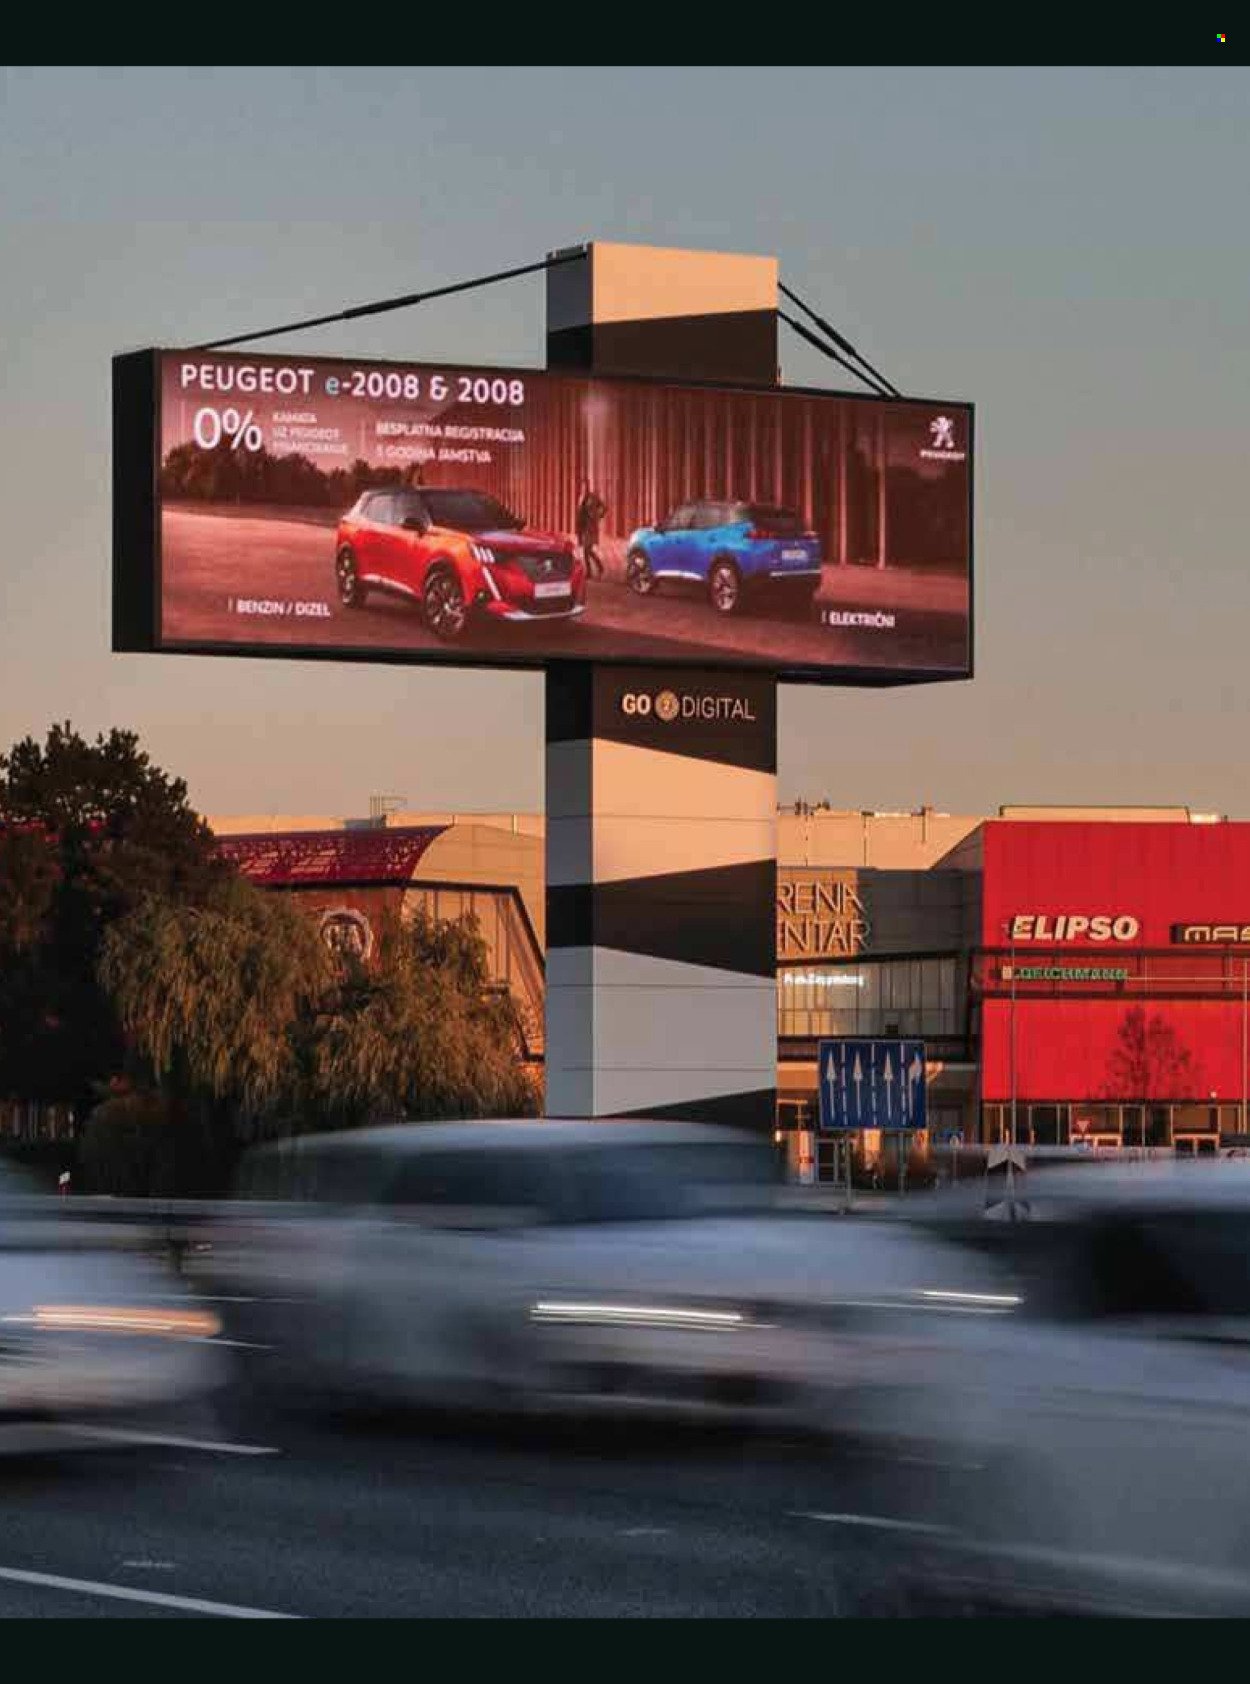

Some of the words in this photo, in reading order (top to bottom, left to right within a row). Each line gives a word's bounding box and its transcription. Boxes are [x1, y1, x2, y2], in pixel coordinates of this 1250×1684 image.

[180, 364, 315, 394] PEUGEOT
[324, 372, 420, 400] e-2008
[429, 376, 449, 401] &
[457, 378, 525, 405] 2008
[193, 408, 263, 452] 0%
[376, 422, 443, 437] BESPLATNA
[444, 426, 525, 443] REGISTRACIJA
[438, 448, 491, 463] JAMSTVA
[236, 600, 283, 615] BENZIN
[295, 601, 331, 617] DIZEL
[622, 694, 651, 716] GO
[682, 696, 756, 720] DIGITAL
[1012, 914, 1140, 942] ELIPSO
